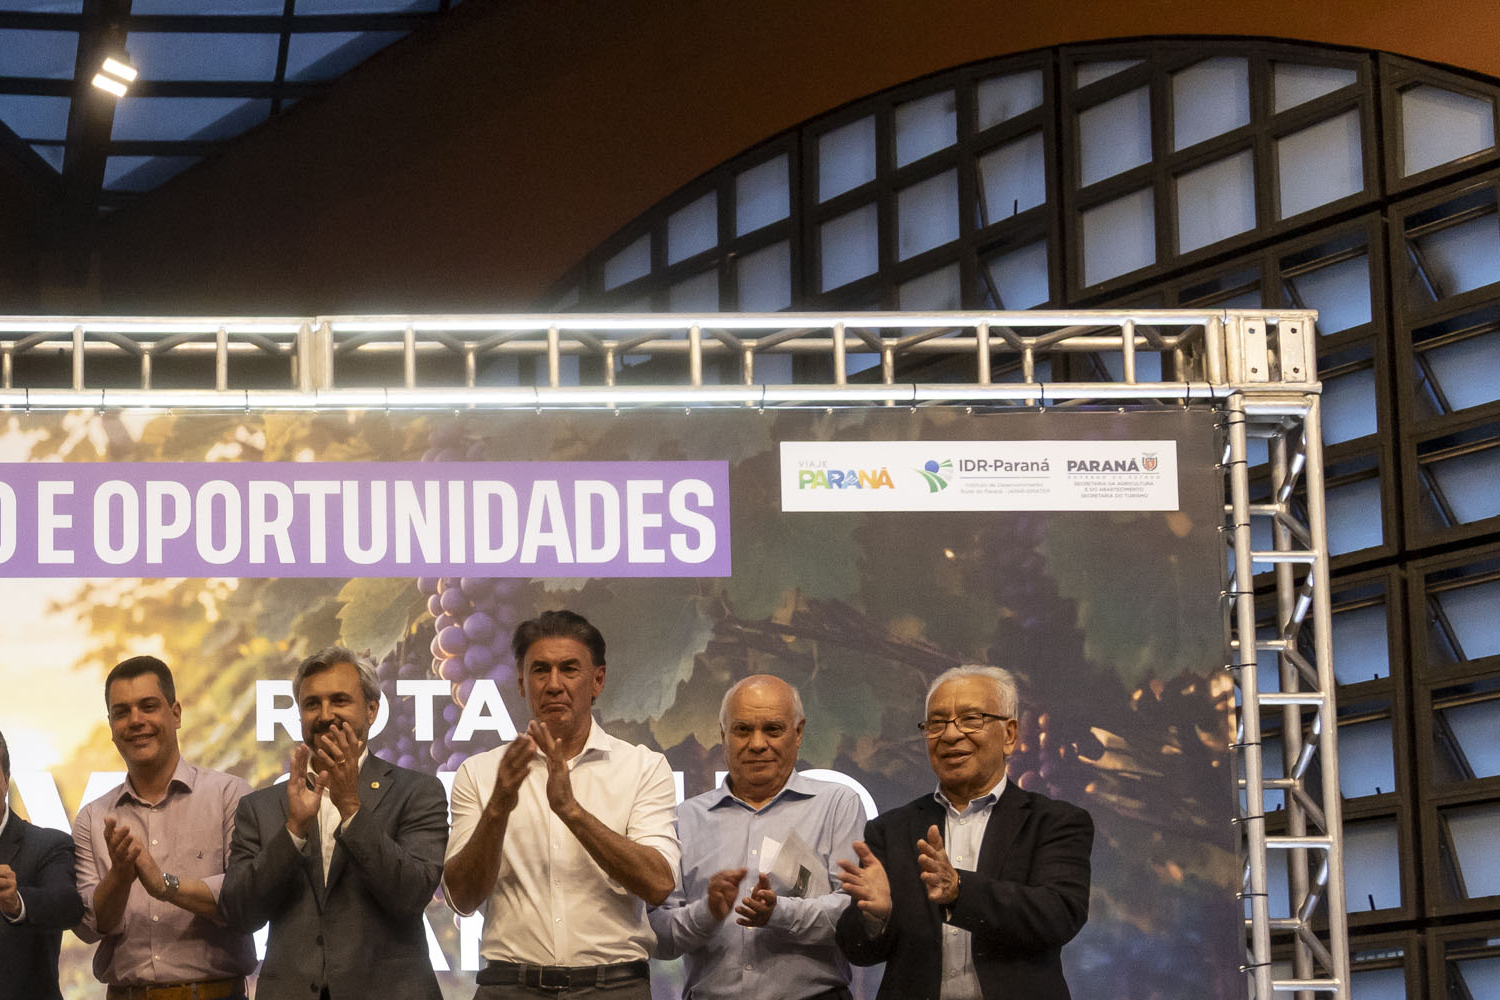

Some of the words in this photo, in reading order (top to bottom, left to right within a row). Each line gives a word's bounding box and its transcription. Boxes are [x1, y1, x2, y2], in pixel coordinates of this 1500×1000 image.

[798, 460, 829, 468] VIAJE
[959, 458, 1050, 472] IDR-Paraná
[1067, 458, 1140, 472] PARANÁ
[798, 467, 895, 490] PARANÁ
[37, 480, 75, 564] E
[93, 479, 716, 564] OPORTUNIDADES
[255, 679, 519, 742] RTA
